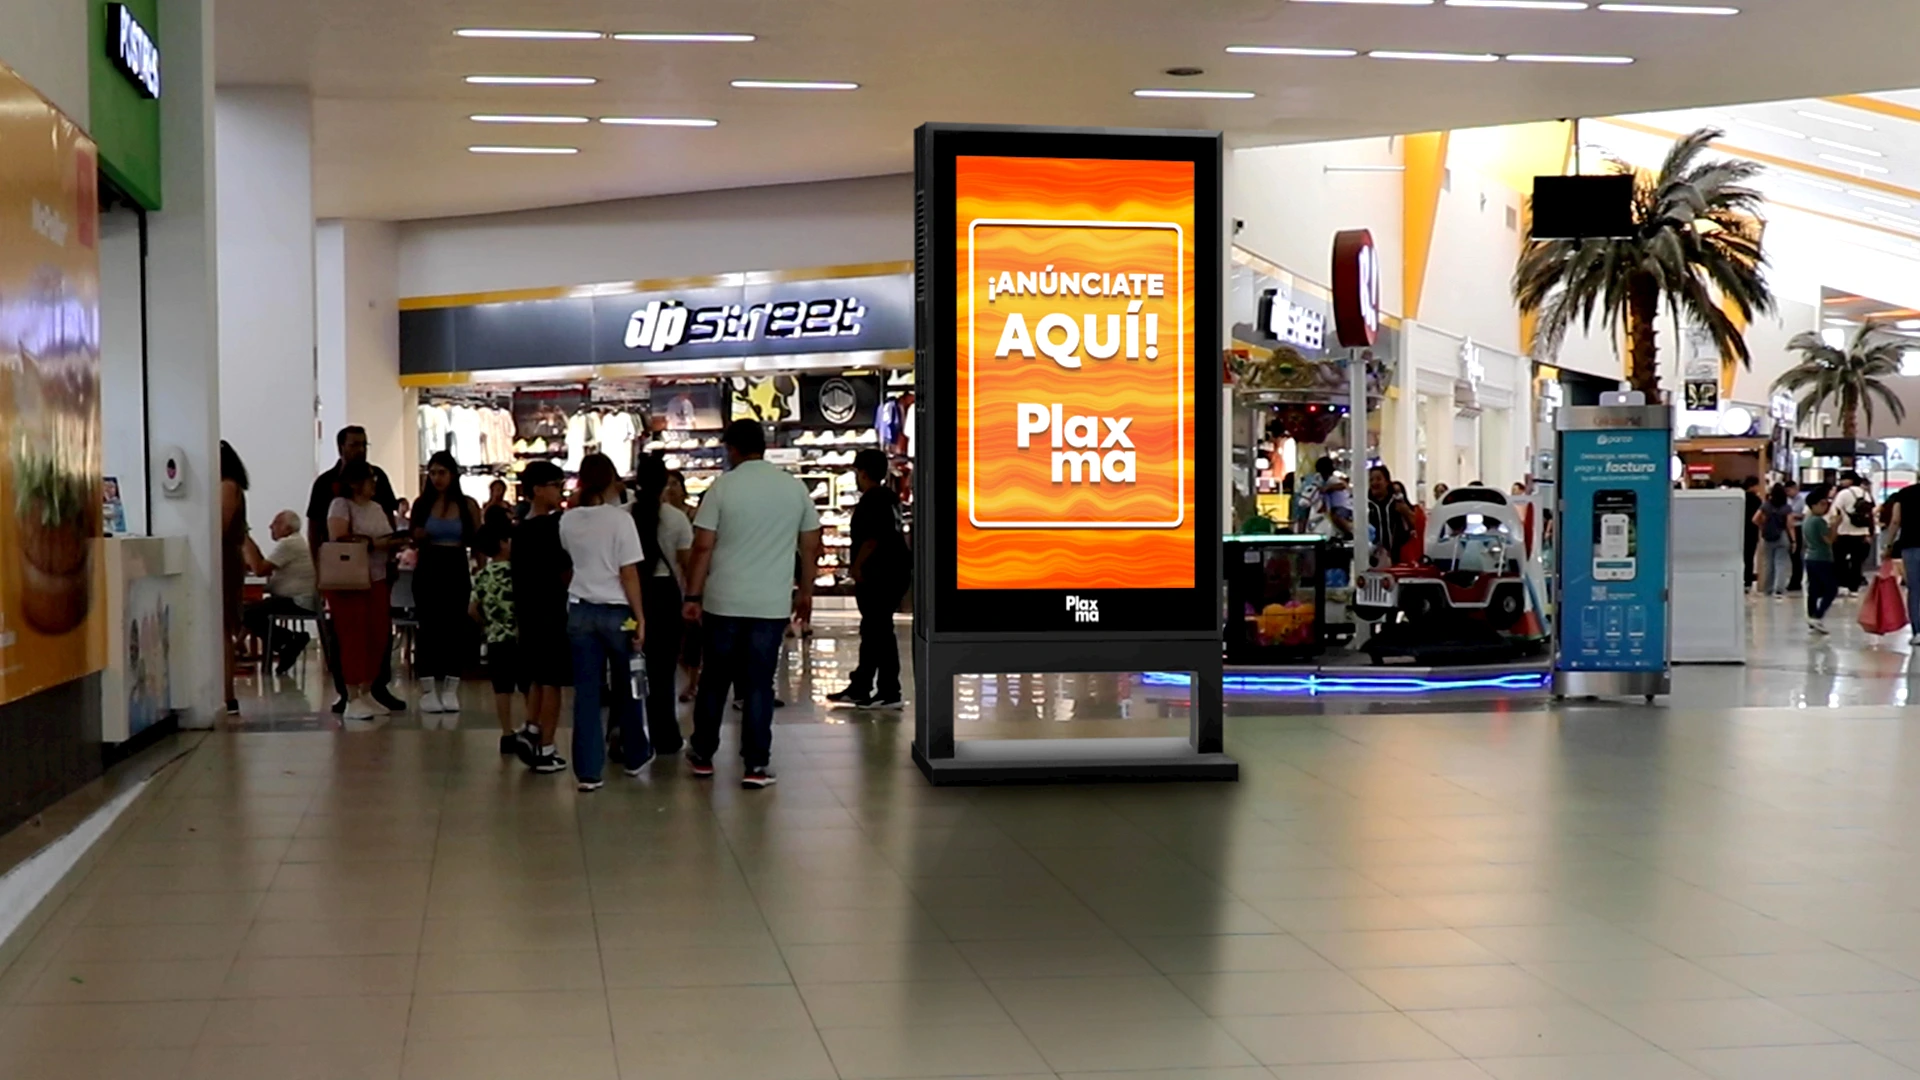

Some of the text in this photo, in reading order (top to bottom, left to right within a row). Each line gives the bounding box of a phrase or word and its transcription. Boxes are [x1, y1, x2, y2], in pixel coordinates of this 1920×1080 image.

[988, 264, 1164, 301] ¡ANÚNCIATE
[994, 300, 1159, 369] AQUÍ!
[1017, 403, 1136, 448] Plax
[1051, 449, 1137, 483] ma
[1605, 461, 1657, 473] factura
[1065, 596, 1099, 611] Plax
[1075, 610, 1100, 623] ma
